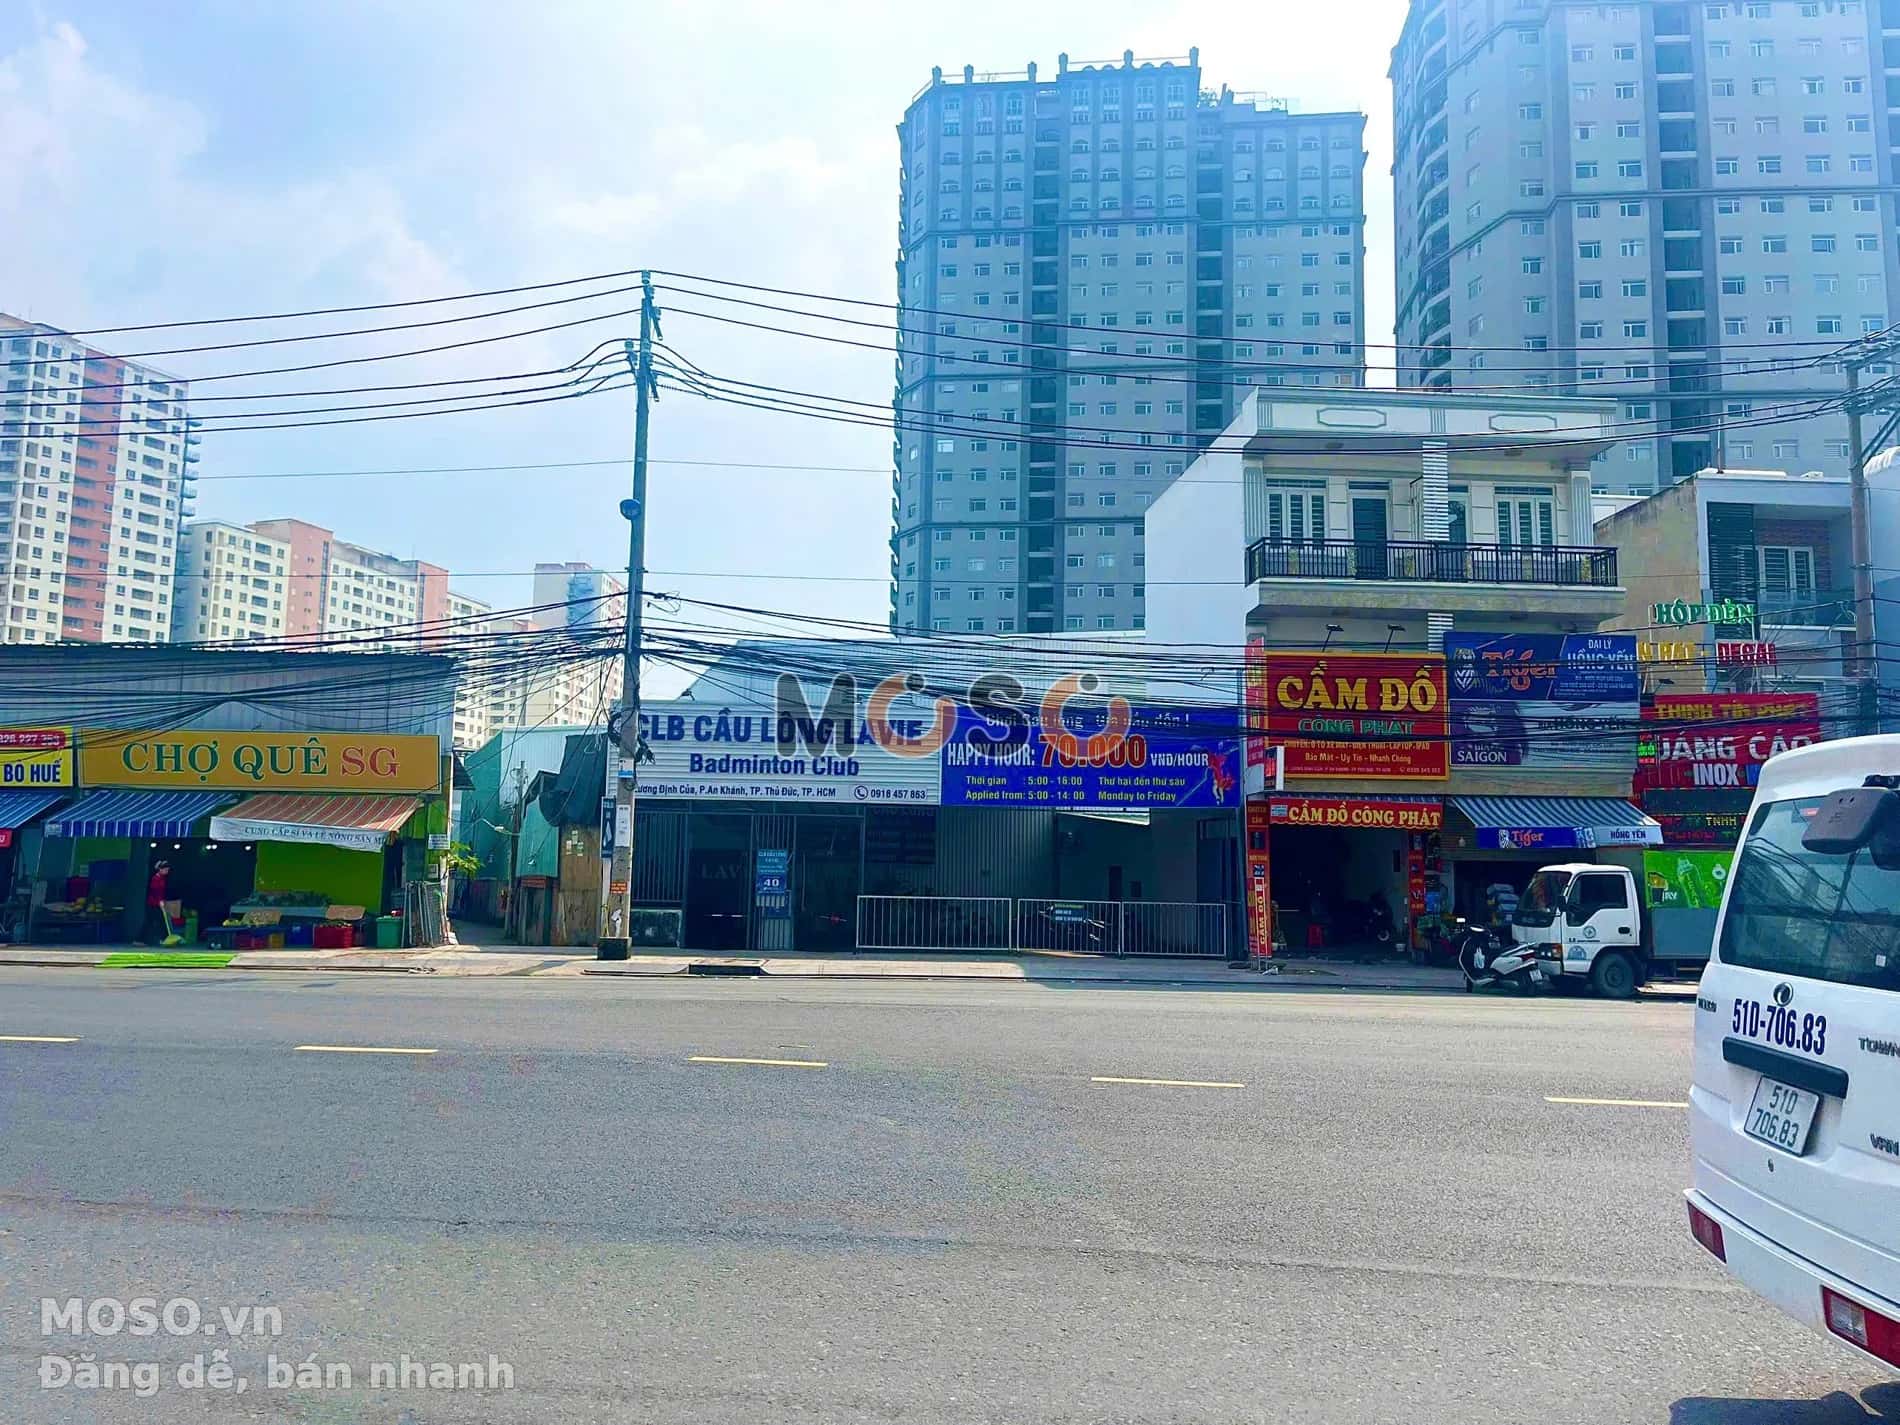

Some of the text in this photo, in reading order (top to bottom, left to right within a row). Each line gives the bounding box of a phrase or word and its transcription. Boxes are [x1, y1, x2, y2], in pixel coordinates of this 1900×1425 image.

[1277, 660, 1368, 711] CẦM
[1379, 664, 1437, 712] ĐỒ
[694, 707, 751, 743] CẦU
[760, 710, 833, 744] LÔNG
[1298, 714, 1354, 735] CÔNG
[122, 736, 401, 782] CHỢ QUÊ SG
[947, 743, 994, 766] HAPPY
[997, 743, 1035, 767] HOUR:
[1039, 733, 1147, 768] 70.000
[1457, 751, 1507, 763] SAIGON
[30, 757, 62, 783] HUẾ
[689, 753, 860, 777] Badminton Club
[1693, 763, 1740, 786] INOX
[659, 783, 677, 797] Định
[817, 787, 836, 798] HCM
[987, 777, 1007, 788] gian
[1028, 776, 1048, 786] 5:00
[965, 790, 999, 803] Applied
[1028, 791, 1048, 801] 5:00
[1098, 791, 1134, 803] Monday
[1136, 791, 1144, 801] to
[1147, 791, 1176, 803] Friday
[1289, 800, 1323, 822] CẦM
[1327, 801, 1348, 823] ĐỒ
[1352, 806, 1394, 825] CÔNG
[1398, 807, 1441, 826] PHÁT
[1512, 830, 1544, 847] Tiger
[1732, 998, 1827, 1056] 51D-706.83
[1769, 1085, 1799, 1115] 51D
[1752, 1108, 1800, 1148] 706.83
